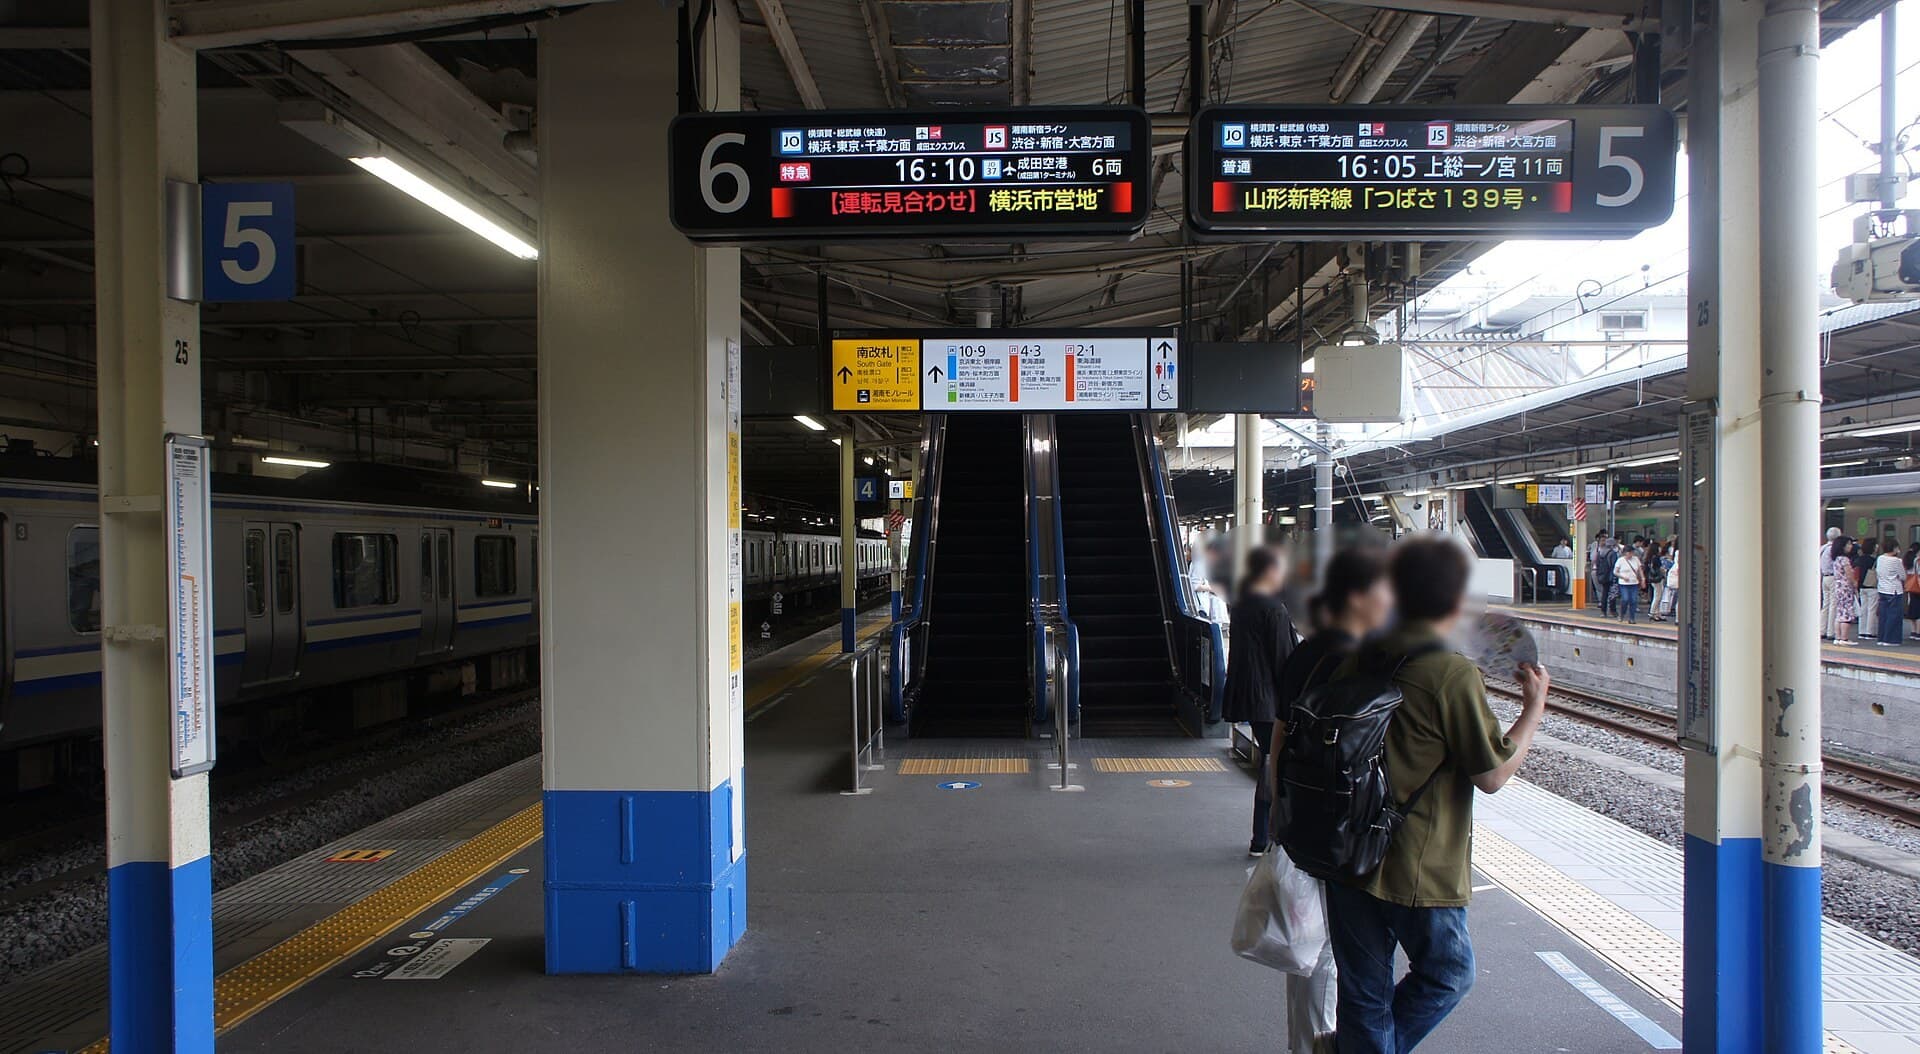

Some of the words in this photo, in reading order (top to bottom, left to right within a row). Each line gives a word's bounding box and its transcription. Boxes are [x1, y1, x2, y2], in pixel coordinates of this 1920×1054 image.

[783, 136, 800, 147] JO
[988, 132, 1002, 143] JS
[1011, 135, 1115, 149] 渋谷・新宿・大宮方面
[1226, 130, 1242, 141] JO
[1250, 135, 1354, 148] 横浜・東京・千葉方面
[1431, 130, 1445, 141] JS
[1454, 135, 1557, 148] 渋谷・新宿・大宮方面
[808, 139, 911, 153] 横浜・東京・千葉方面
[916, 141, 966, 151] 成田エクスプレス
[1358, 138, 1408, 148] 成田エクスプレス
[896, 157, 975, 182] 16:10
[1017, 157, 1068, 170] 成田空港
[1222, 160, 1251, 174] 普通
[1337, 155, 1416, 178] 16:05
[1424, 155, 1517, 178] 上総一ノ宮
[1596, 126, 1645, 207] 5
[700, 132, 750, 214] 6
[781, 166, 809, 180] 特急
[832, 189, 976, 214] 【運転見合わせ】
[989, 188, 1104, 213] 横浜市営地
[221, 202, 276, 285] 5
[1697, 300, 1709, 327] 25
[175, 339, 189, 365] 25
[857, 346, 893, 358] 南改札
[861, 481, 874, 498] 4
[18, 525, 26, 539] 3
